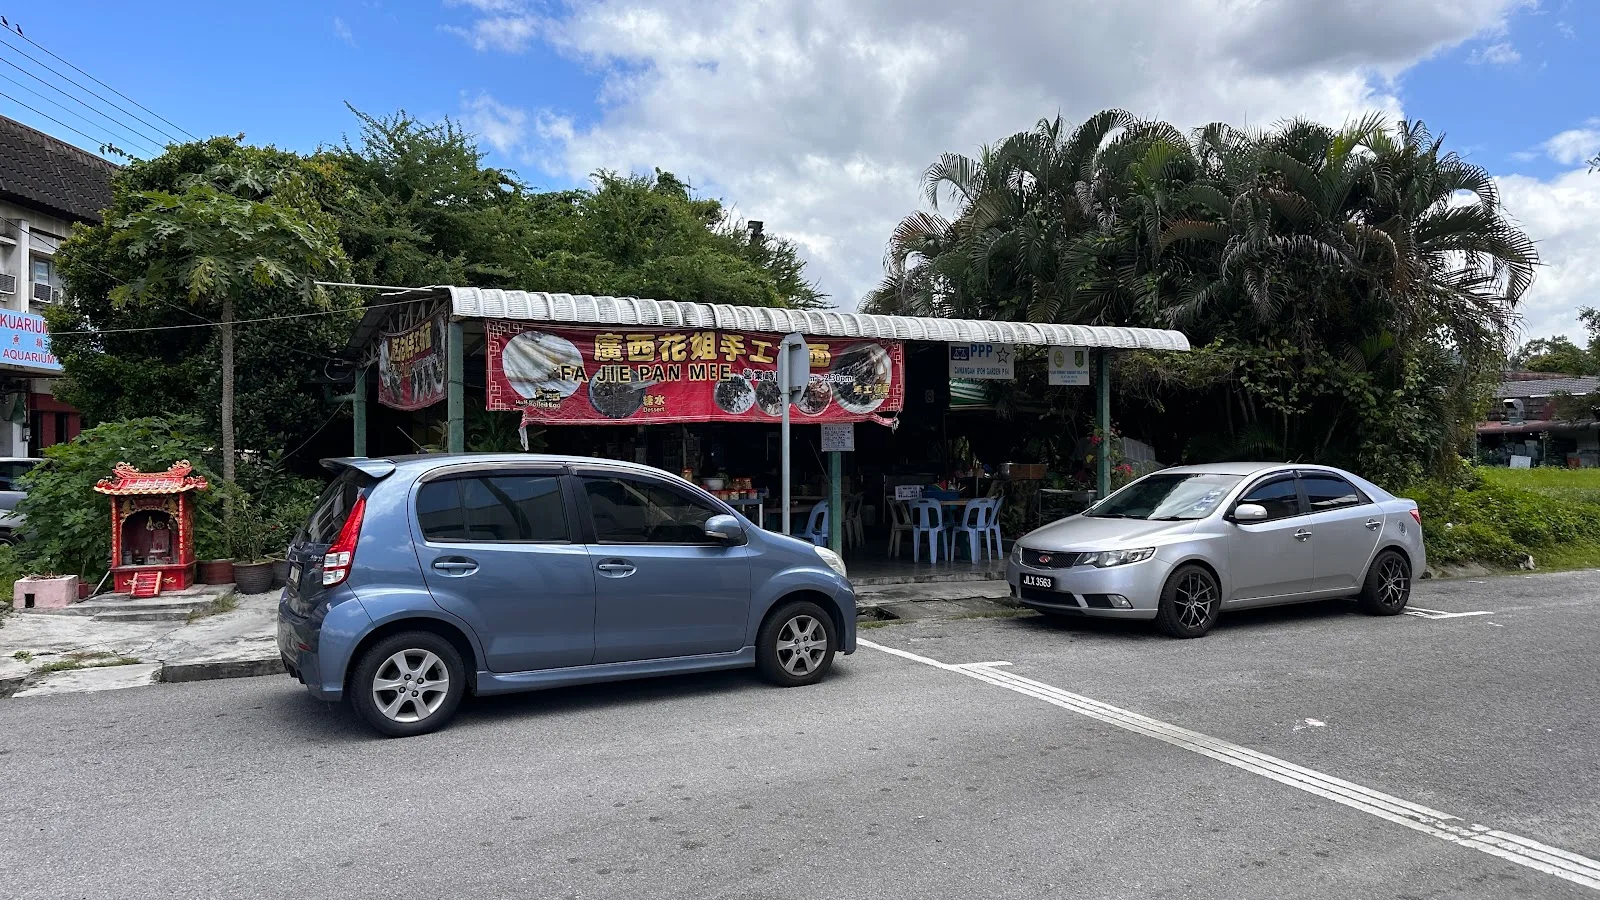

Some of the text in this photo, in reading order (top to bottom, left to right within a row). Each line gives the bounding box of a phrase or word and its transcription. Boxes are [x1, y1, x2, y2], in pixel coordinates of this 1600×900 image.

[3, 348, 55, 364] AQUARIUM
[593, 331, 832, 368] 廣西花姐手工面
[971, 343, 992, 357] PPP
[559, 363, 732, 383] FA JIE PAN MEE
[743, 368, 778, 382] 營業時
[986, 367, 1001, 376] GARDEN
[1024, 575, 1051, 588] JLX 3563
